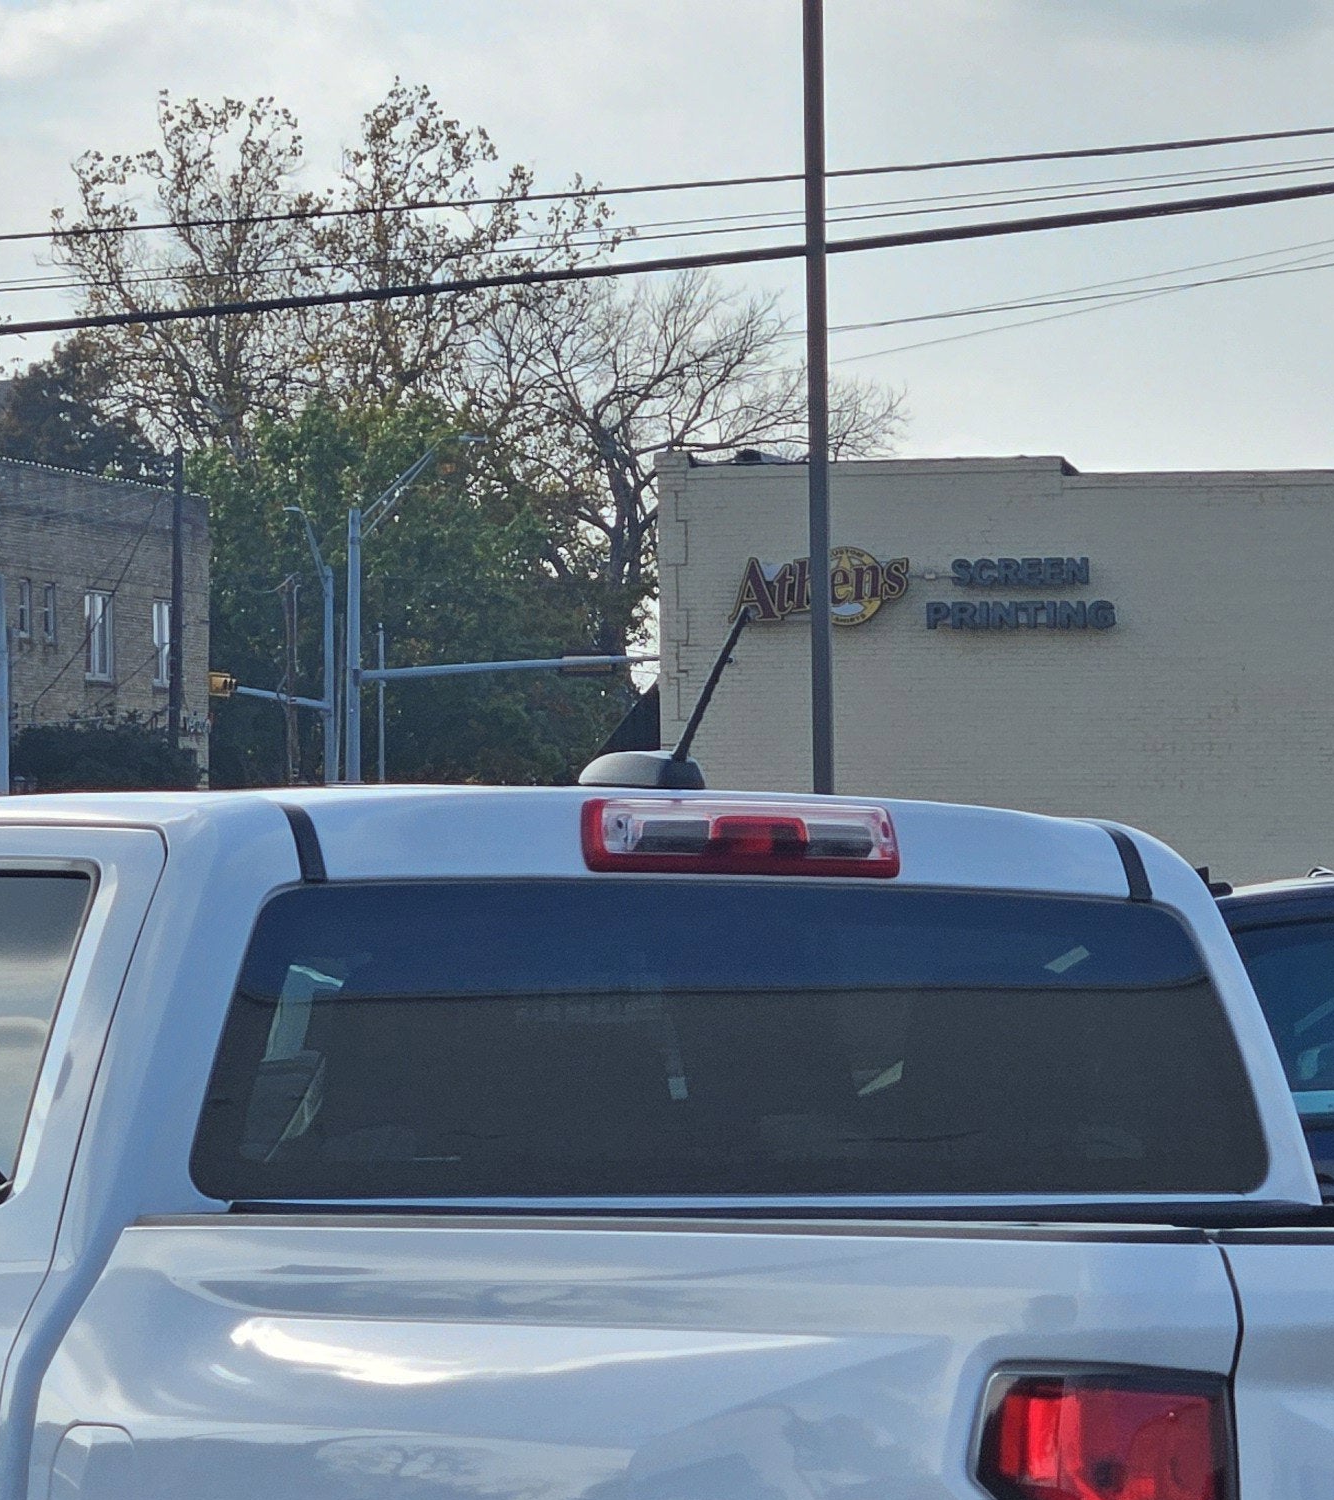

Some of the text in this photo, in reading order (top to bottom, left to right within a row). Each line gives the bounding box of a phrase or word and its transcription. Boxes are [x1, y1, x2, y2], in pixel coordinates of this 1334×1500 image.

[951, 557, 1090, 586] SCREEN
[728, 556, 909, 624] Athens
[926, 600, 1117, 629] PRINTING
